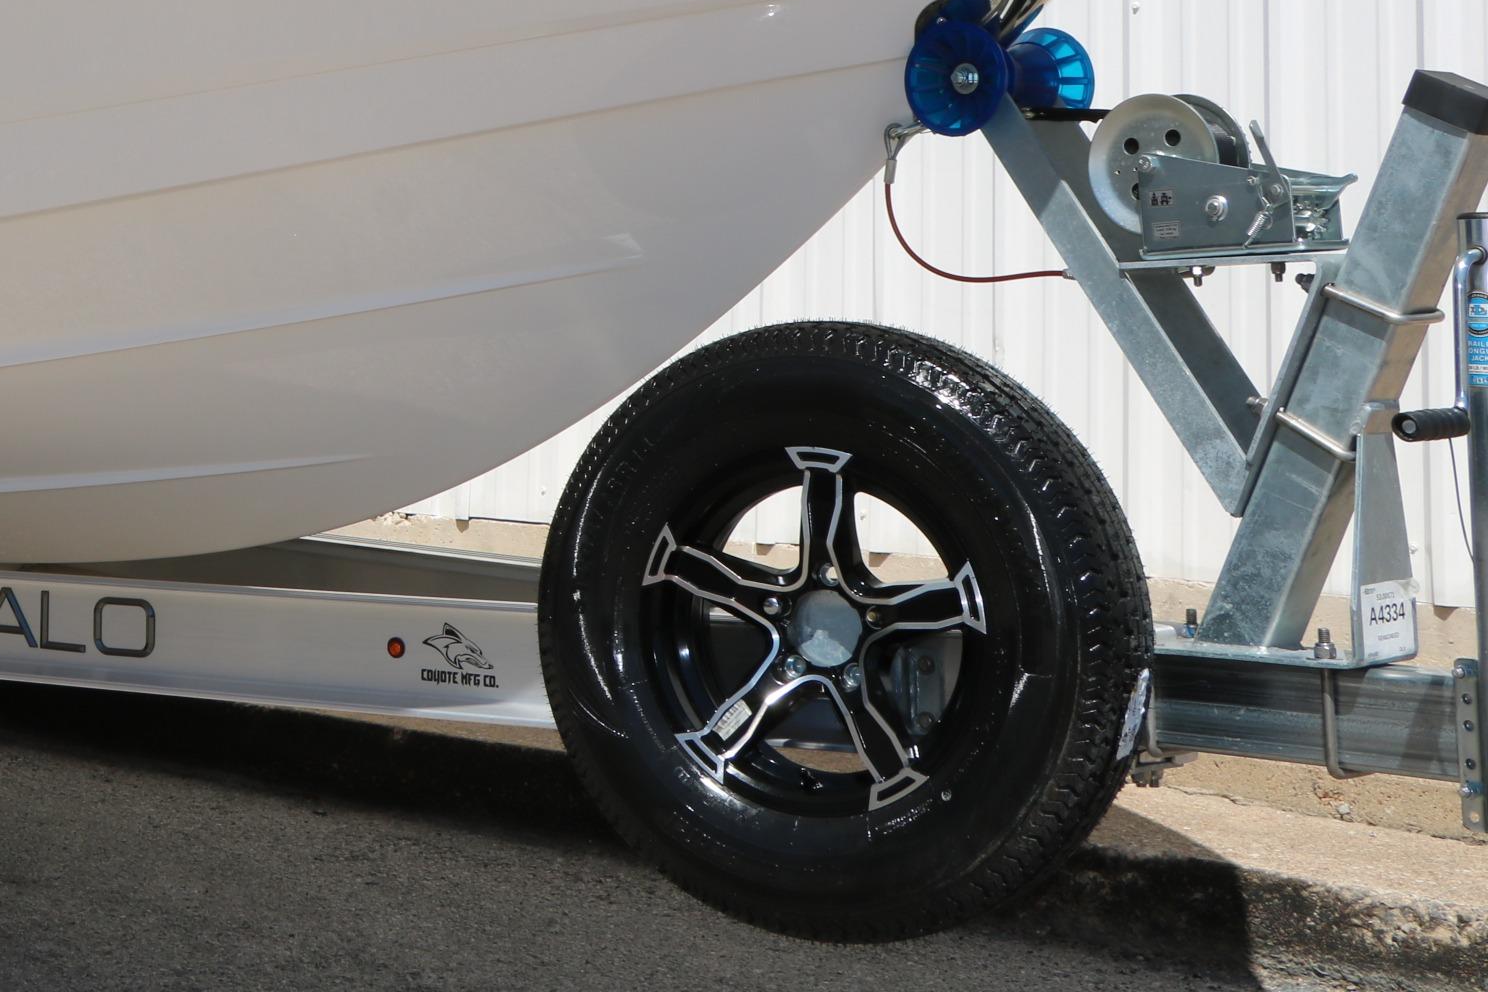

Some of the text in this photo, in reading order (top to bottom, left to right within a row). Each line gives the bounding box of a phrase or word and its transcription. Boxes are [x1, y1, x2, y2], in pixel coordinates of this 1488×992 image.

[1369, 601, 1405, 626] A4334
[420, 668, 500, 689] COYOTE MFG CO.
